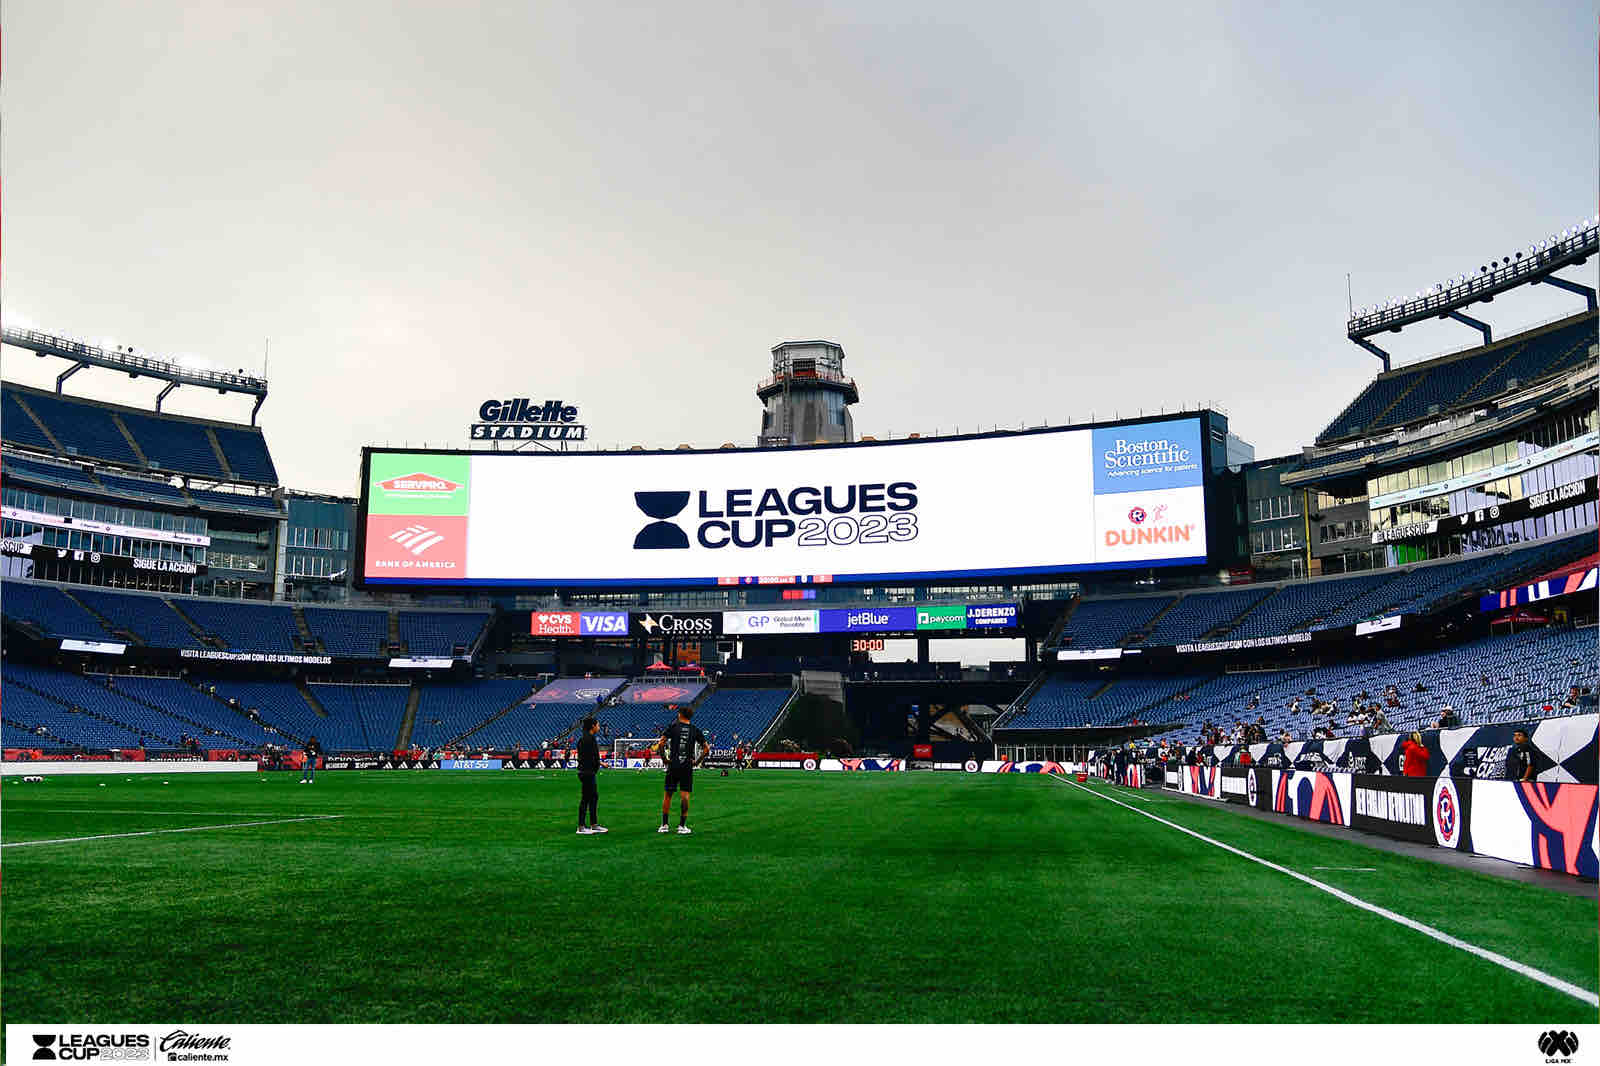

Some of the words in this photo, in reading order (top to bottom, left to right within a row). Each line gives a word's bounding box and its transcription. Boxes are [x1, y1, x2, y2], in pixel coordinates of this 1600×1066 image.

[480, 398, 577, 422] Gillette
[472, 426, 583, 439] STADIUM
[1116, 438, 1168, 455] Boston
[1105, 443, 1190, 468] Scientific
[699, 481, 918, 518] LEAGUES
[1529, 491, 1549, 509] SIGUE
[1549, 489, 1559, 503] LA
[697, 518, 796, 549] CUP
[798, 512, 919, 547] 2023
[133, 558, 157, 570] SIGUE
[157, 561, 168, 571] LA
[550, 615, 572, 624] CVS
[583, 615, 626, 632] VISA
[848, 612, 889, 628] jetBlue
[853, 639, 883, 651] 30:00
[453, 760, 475, 769] AT&T
[475, 760, 489, 768] 5G
